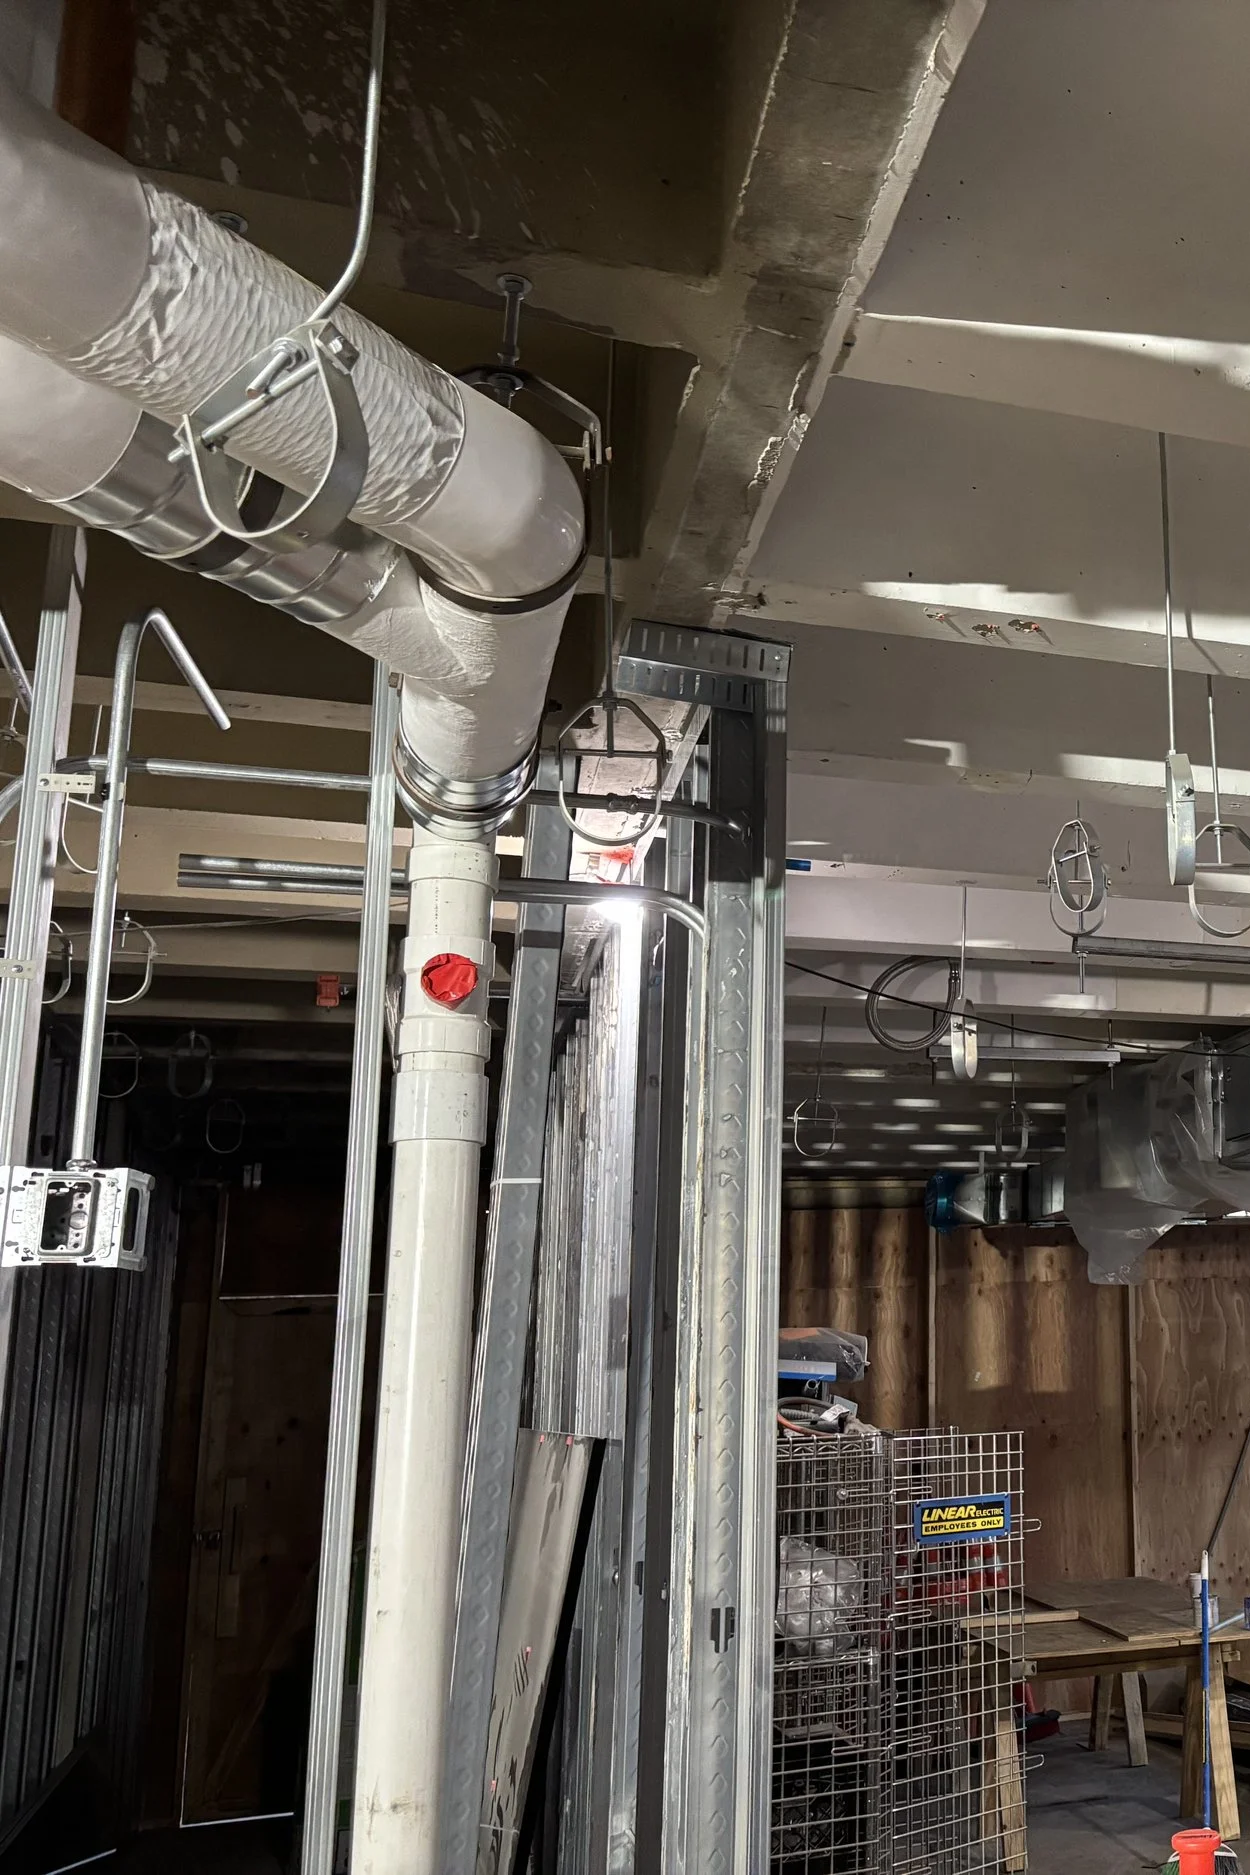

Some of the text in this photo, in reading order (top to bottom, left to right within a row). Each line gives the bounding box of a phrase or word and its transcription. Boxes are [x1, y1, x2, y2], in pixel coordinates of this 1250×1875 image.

[922, 1505, 1003, 1522] LINEAR ELECTRIC
[924, 1518, 1001, 1533] EMPLOYEES ONLY
